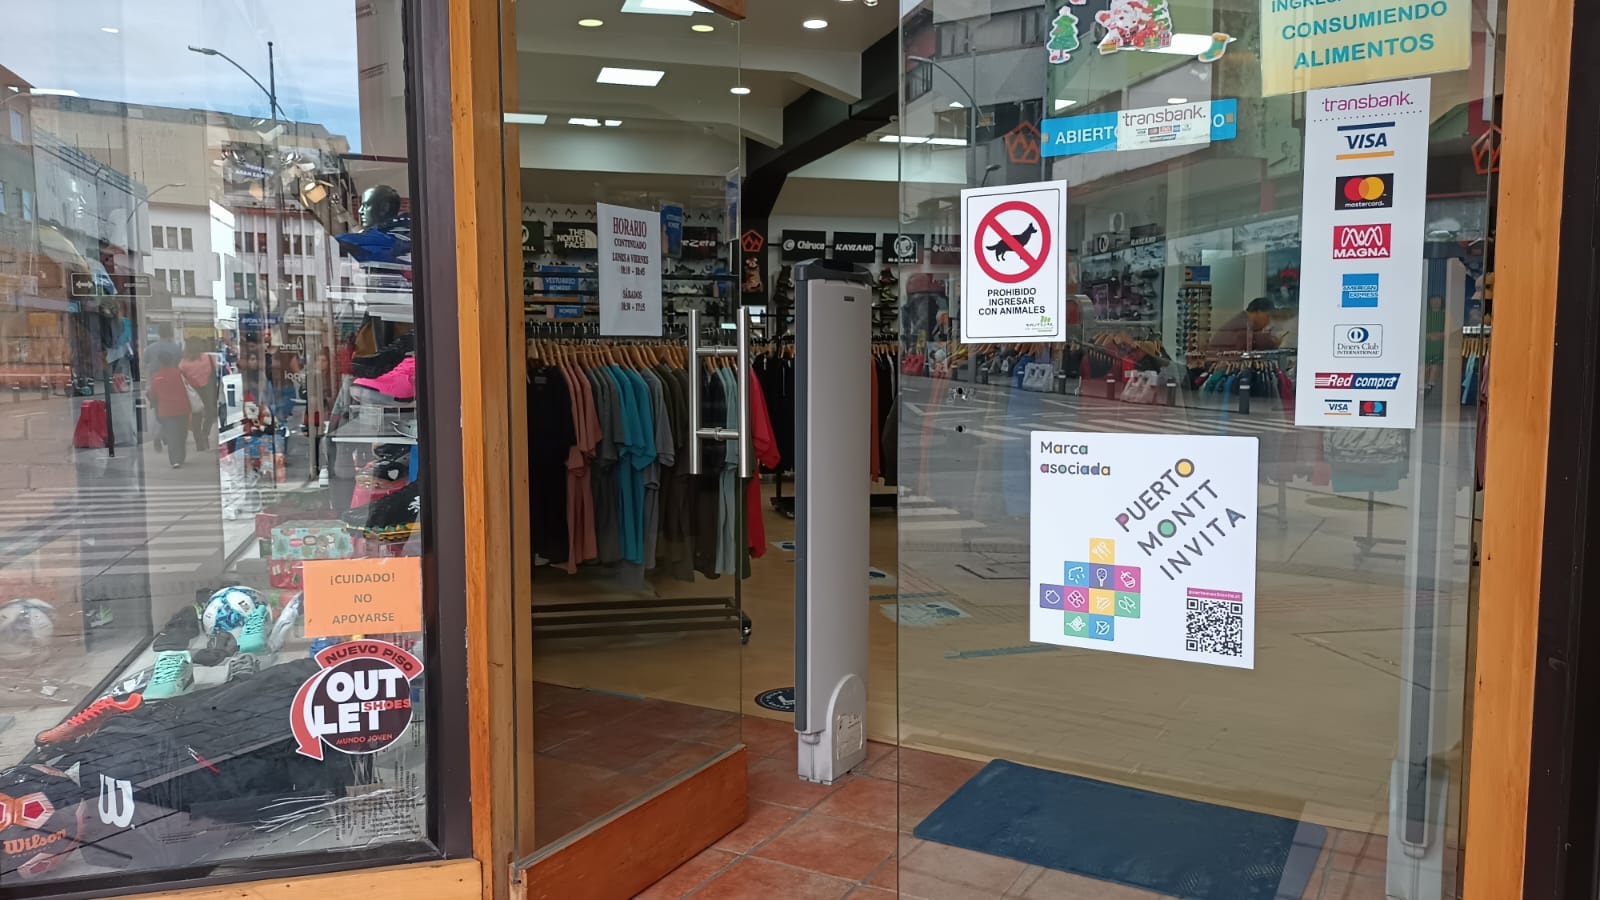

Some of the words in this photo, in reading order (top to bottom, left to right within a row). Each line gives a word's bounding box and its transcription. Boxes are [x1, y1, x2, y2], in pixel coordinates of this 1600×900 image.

[1282, 1, 1447, 40] CONSUMIENDO
[1294, 33, 1434, 69] ALIMENTOS
[1344, 133, 1388, 150] VISA
[613, 217, 647, 238] HORARIO
[797, 240, 825, 250] Chiruca
[1334, 248, 1389, 258] MAGNA
[987, 288, 1037, 297] PROHIBIDO
[988, 297, 1035, 306] INGRESAR
[979, 308, 998, 316] CON
[1000, 306, 1046, 315] ANIMALES
[1361, 342, 1379, 350] Club
[1328, 374, 1354, 387] Red
[1040, 441, 1088, 455] Marca
[1040, 461, 1111, 476] asociada
[1115, 458, 1195, 533] PUERTO
[1137, 479, 1218, 556] MONTT
[1159, 507, 1246, 581] INVITA
[330, 572, 395, 585] ¡CUIDADO!
[353, 593, 373, 604] NO
[332, 612, 395, 625] APOYARSE
[324, 644, 379, 664] NUEVO
[382, 647, 413, 672] PISO
[326, 668, 403, 703] OUT
[363, 700, 411, 711] SHOES
[336, 735, 367, 746] MUNDO
[2, 829, 67, 855] Wilson
